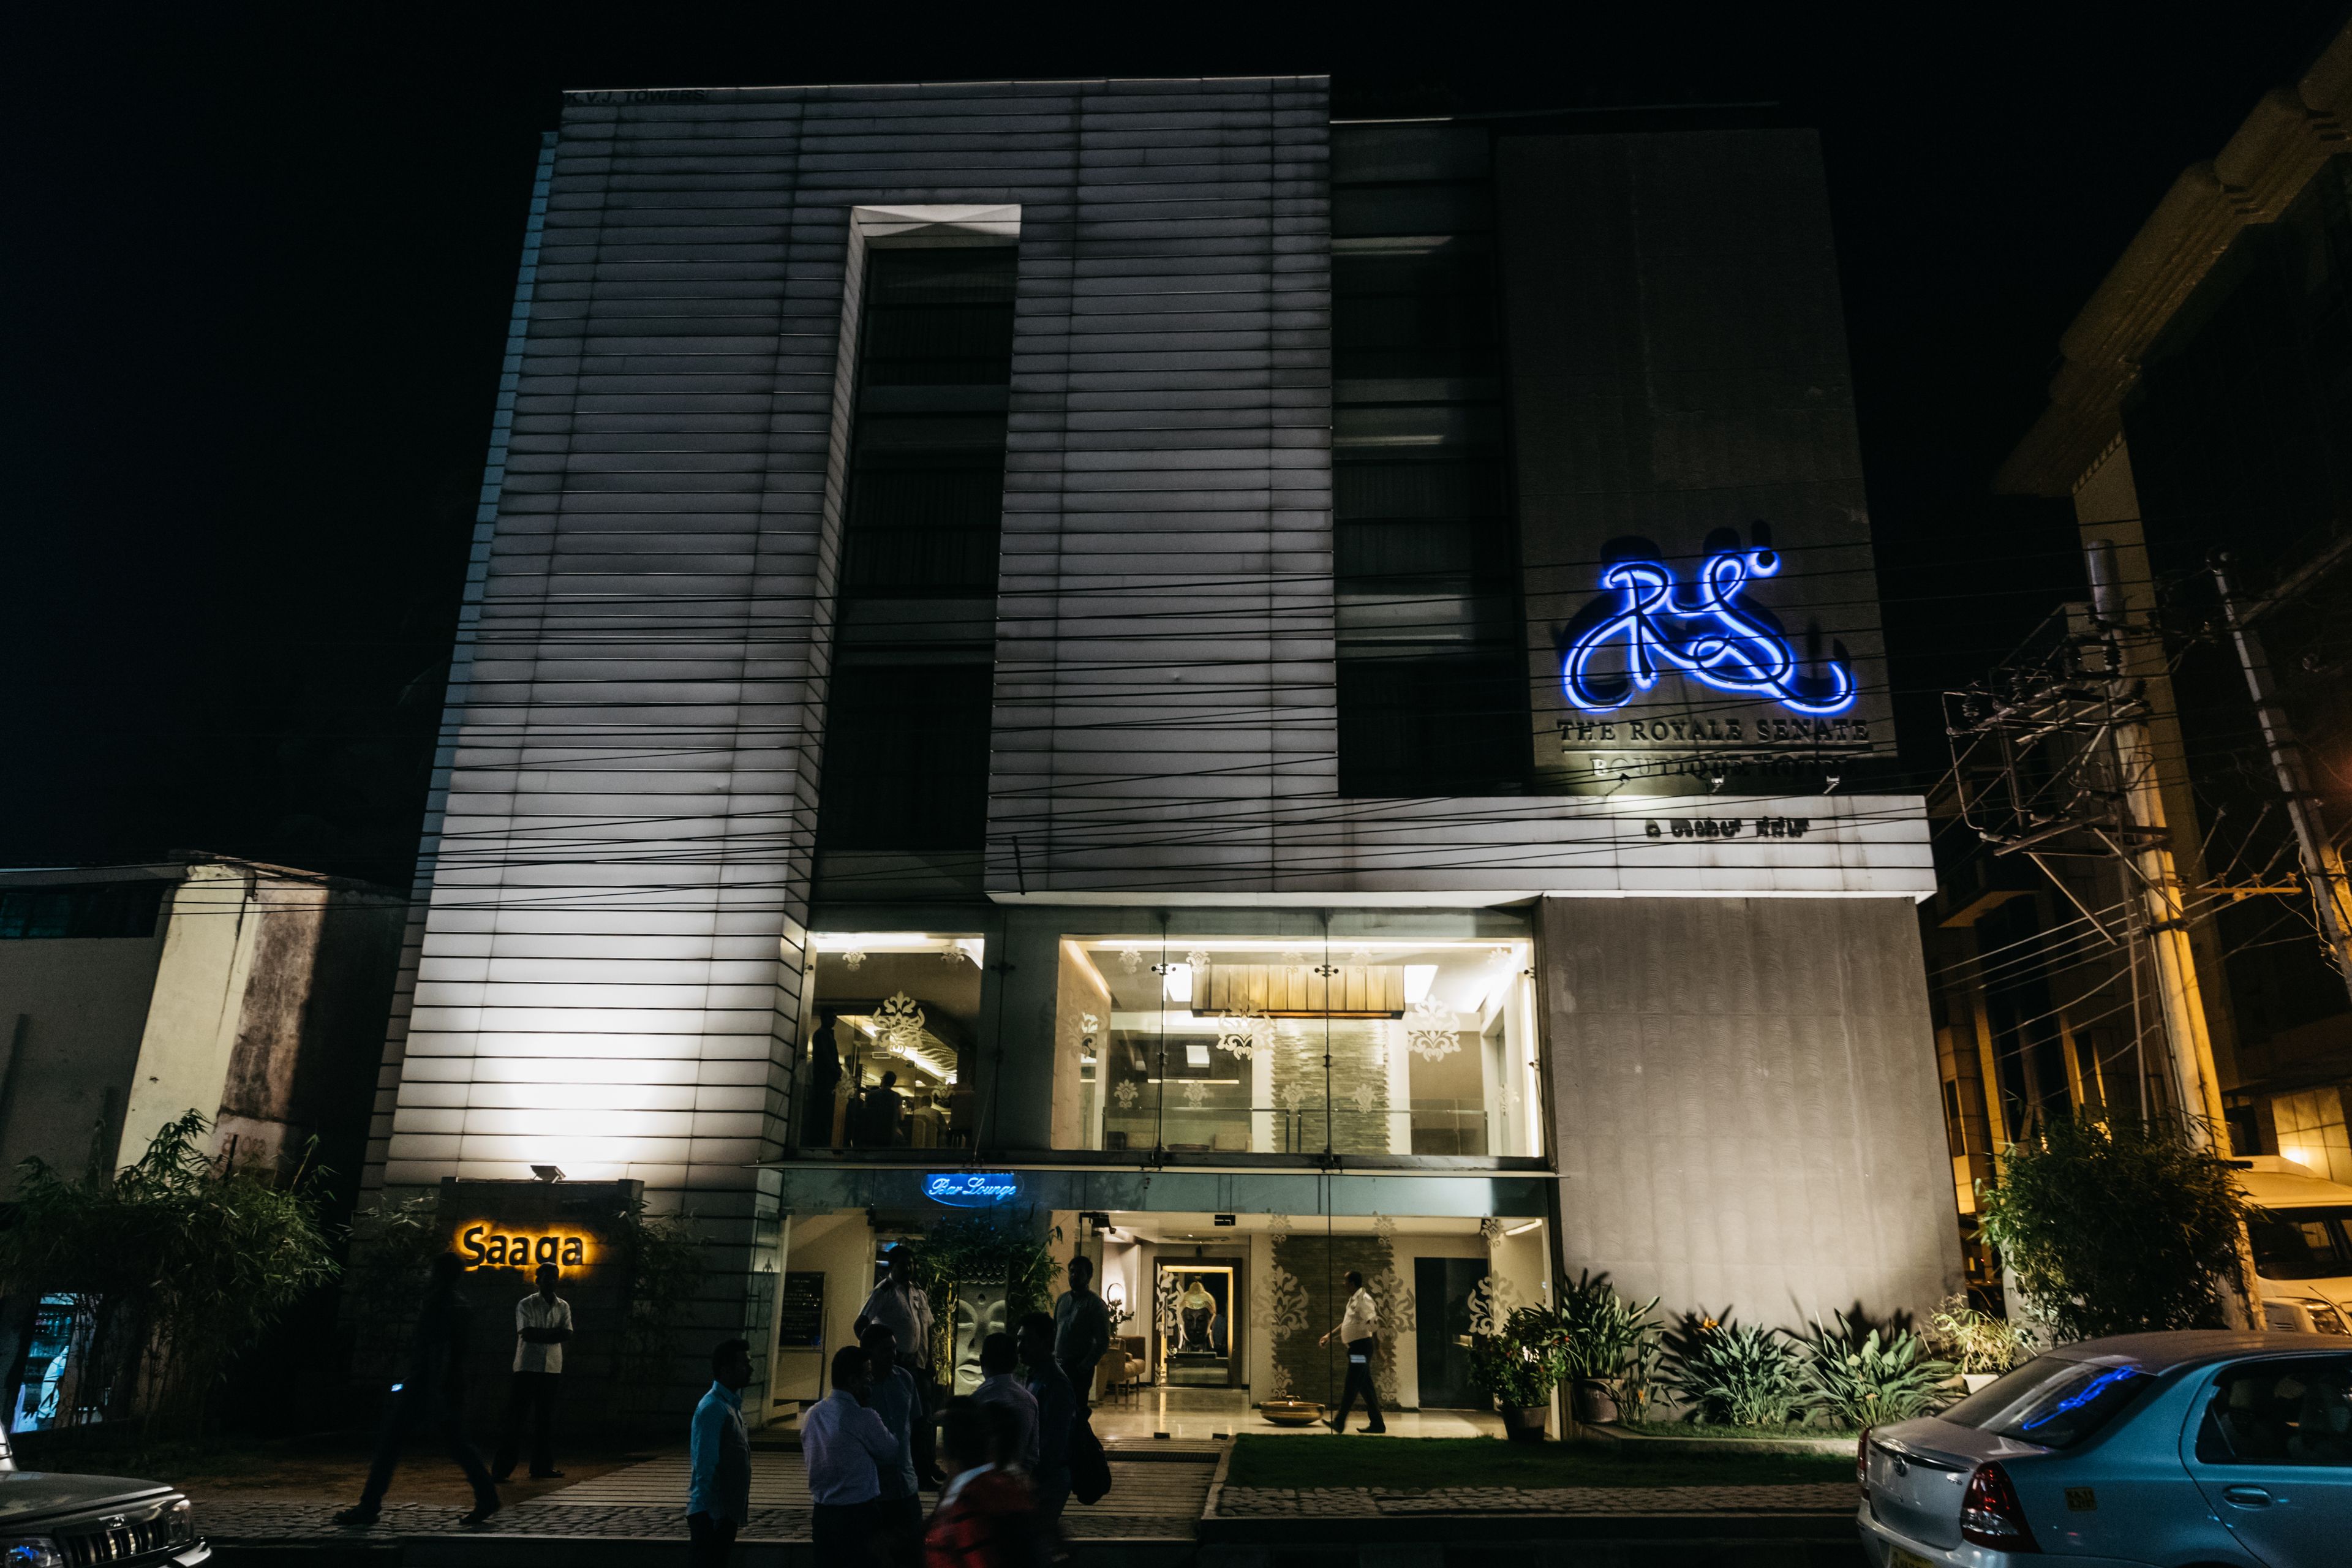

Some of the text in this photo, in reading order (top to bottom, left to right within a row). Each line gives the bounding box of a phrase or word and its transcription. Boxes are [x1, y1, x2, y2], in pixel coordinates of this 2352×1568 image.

[625, 90, 706, 102] TOWERS
[1556, 719, 1869, 743] THE ROYALE SENATE
[1590, 755, 1746, 780] BOUTIQUE
[929, 1177, 1017, 1200] Bar Lounge
